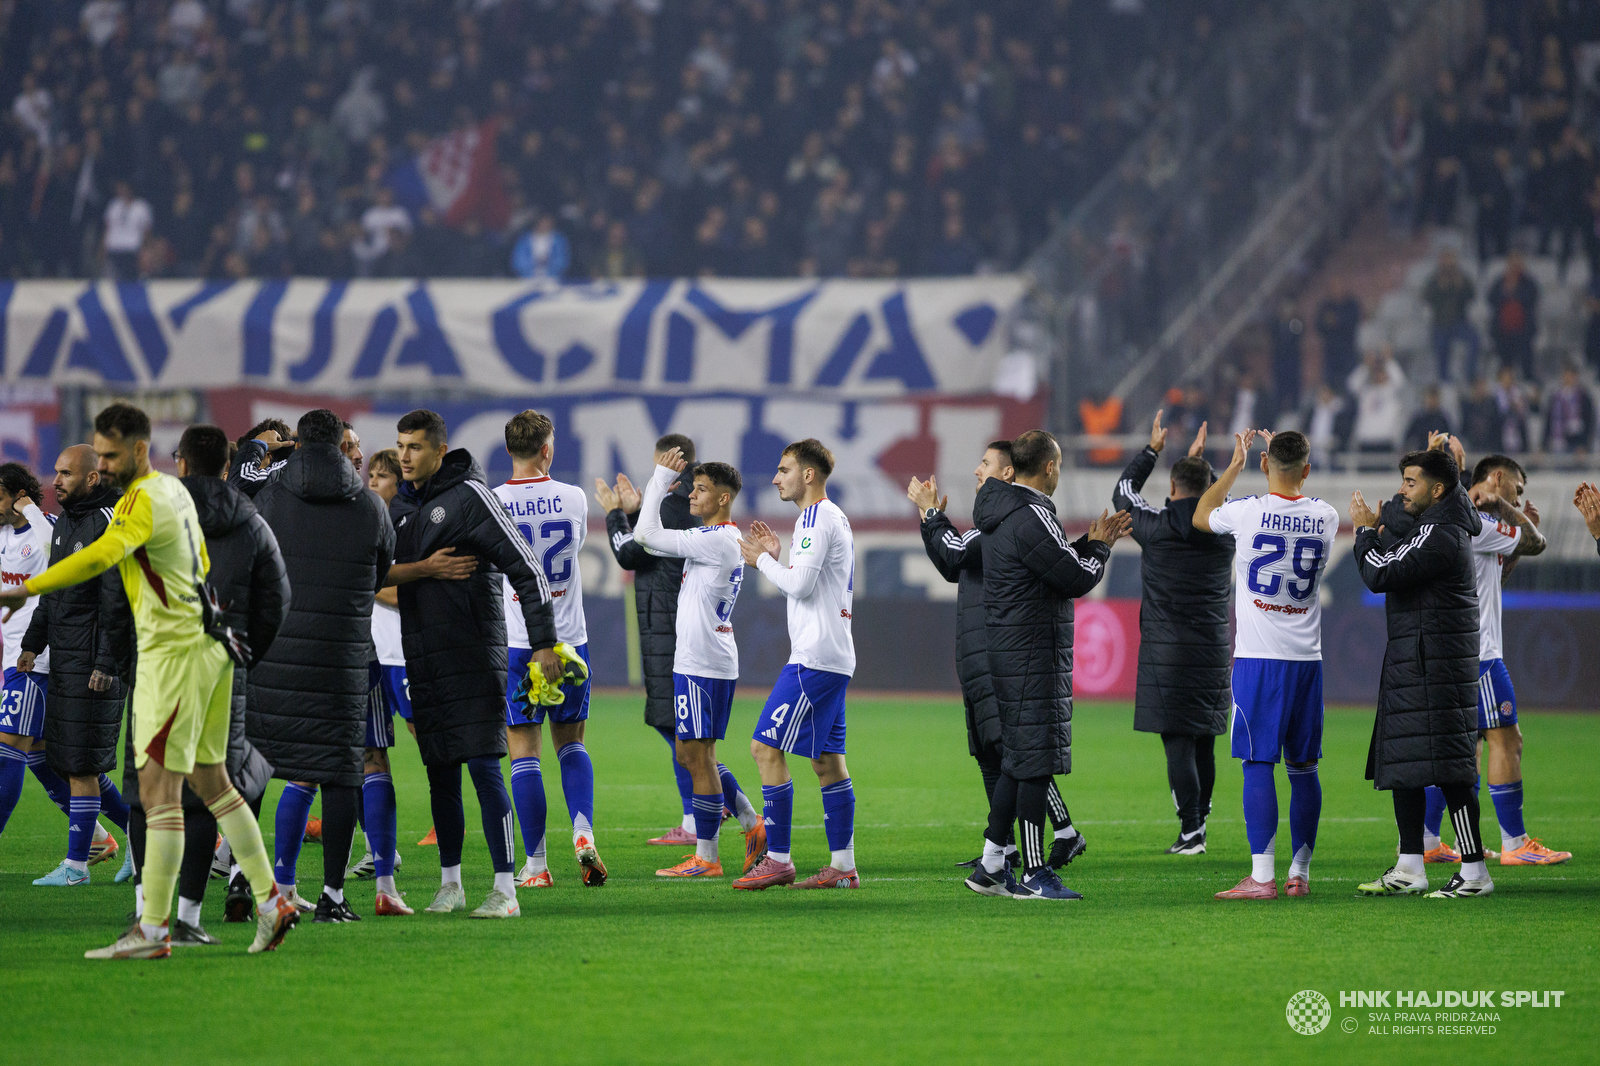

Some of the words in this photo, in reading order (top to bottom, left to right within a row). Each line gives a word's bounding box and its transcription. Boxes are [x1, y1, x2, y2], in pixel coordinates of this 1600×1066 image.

[0, 278, 942, 386] AVIJAČIMA
[504, 496, 562, 517] MLAČIĆ
[1261, 512, 1325, 534] KARAČIĆ
[2, 571, 31, 586] OMMY
[1246, 532, 1326, 602] 29
[1253, 599, 1309, 615] SuperSport
[0, 689, 23, 715] 23
[674, 694, 689, 720] 8
[770, 703, 790, 728] 4
